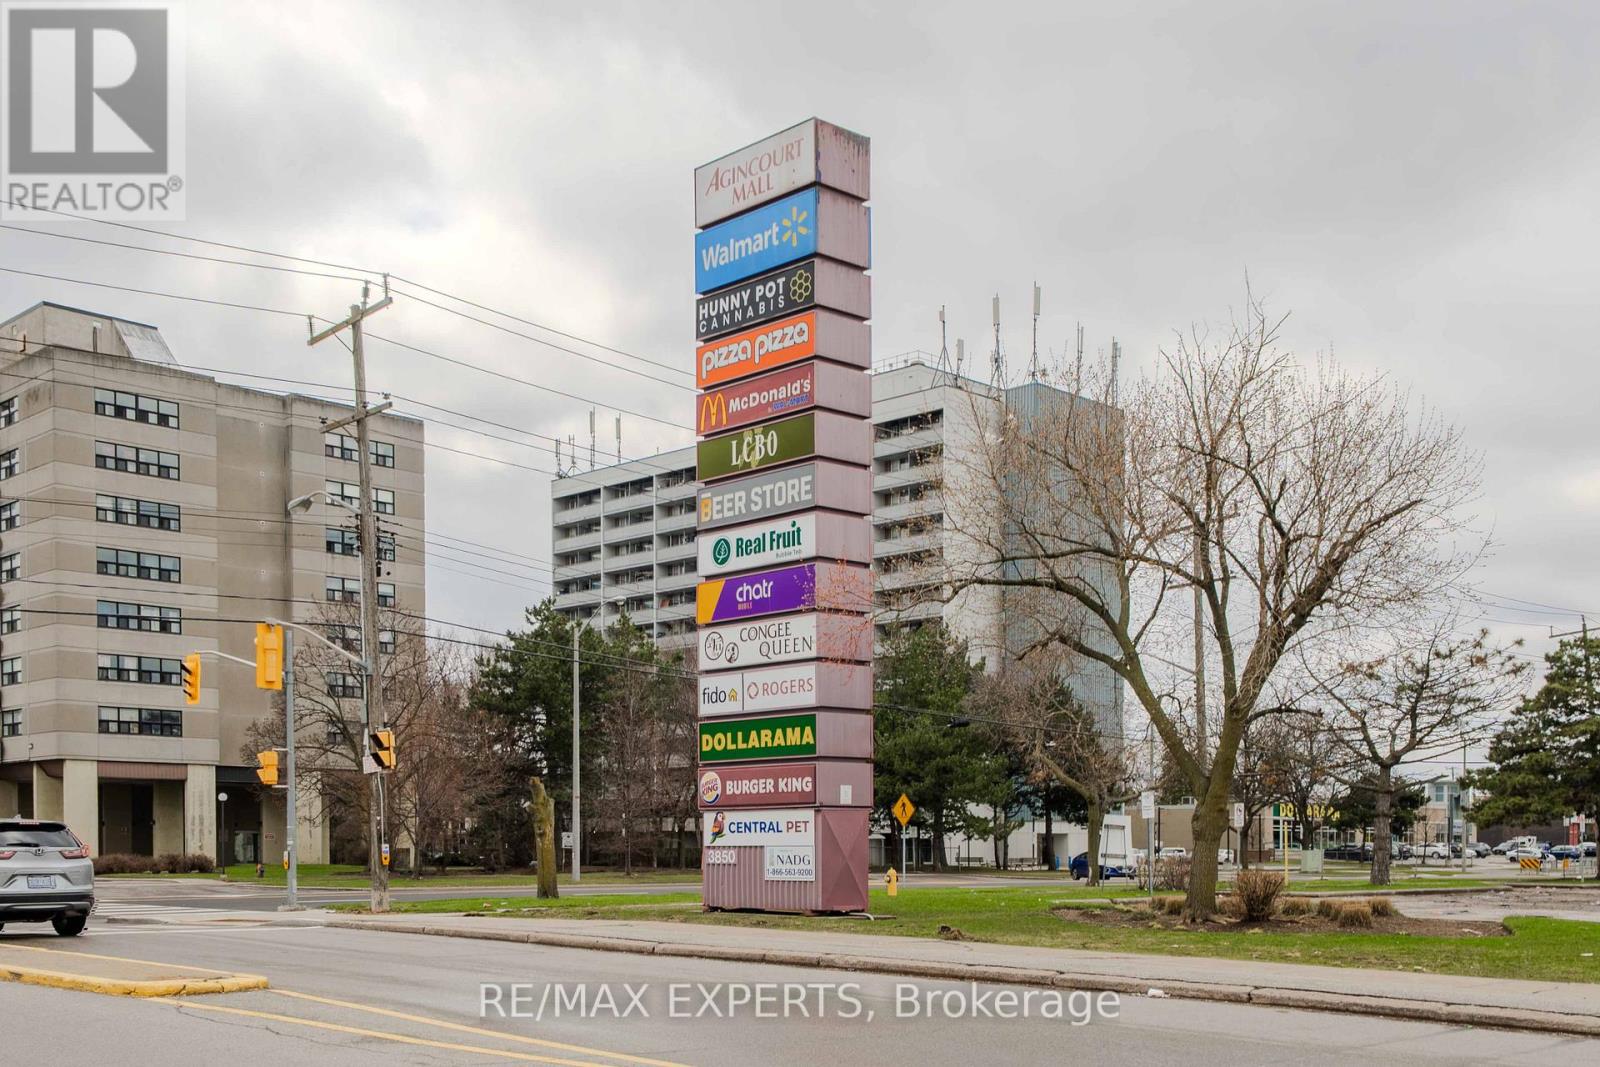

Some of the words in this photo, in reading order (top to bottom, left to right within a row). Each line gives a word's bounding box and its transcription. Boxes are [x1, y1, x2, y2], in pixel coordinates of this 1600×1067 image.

[705, 138, 804, 197] AGINCOURT
[732, 173, 774, 205] MALL
[702, 222, 779, 271] Walmart
[700, 289, 750, 320] HUNNY
[755, 277, 786, 302] POT
[700, 295, 785, 333] CANNABIS
[701, 339, 752, 380] pizza
[754, 321, 809, 364] pizza
[728, 378, 811, 413] McDonald's
[731, 430, 778, 466] LCBO
[701, 490, 746, 523] BEER
[750, 475, 812, 512] STORE
[736, 533, 766, 557] Real
[769, 520, 802, 551] Fruit
[736, 579, 774, 602] chatr
[740, 622, 792, 642] CONGEE
[759, 635, 812, 660] QUEEN
[702, 686, 727, 704] fido
[762, 677, 814, 697] ROGERS
[701, 726, 815, 752] DOLLARAMA
[726, 778, 775, 795] BURGER
[778, 776, 813, 793] KING
[1280, 802, 1340, 821] DOARA
[728, 821, 783, 834] CENTRAL
[786, 820, 810, 833] PET
[708, 850, 736, 864] 3850
[776, 854, 811, 866] NADG
